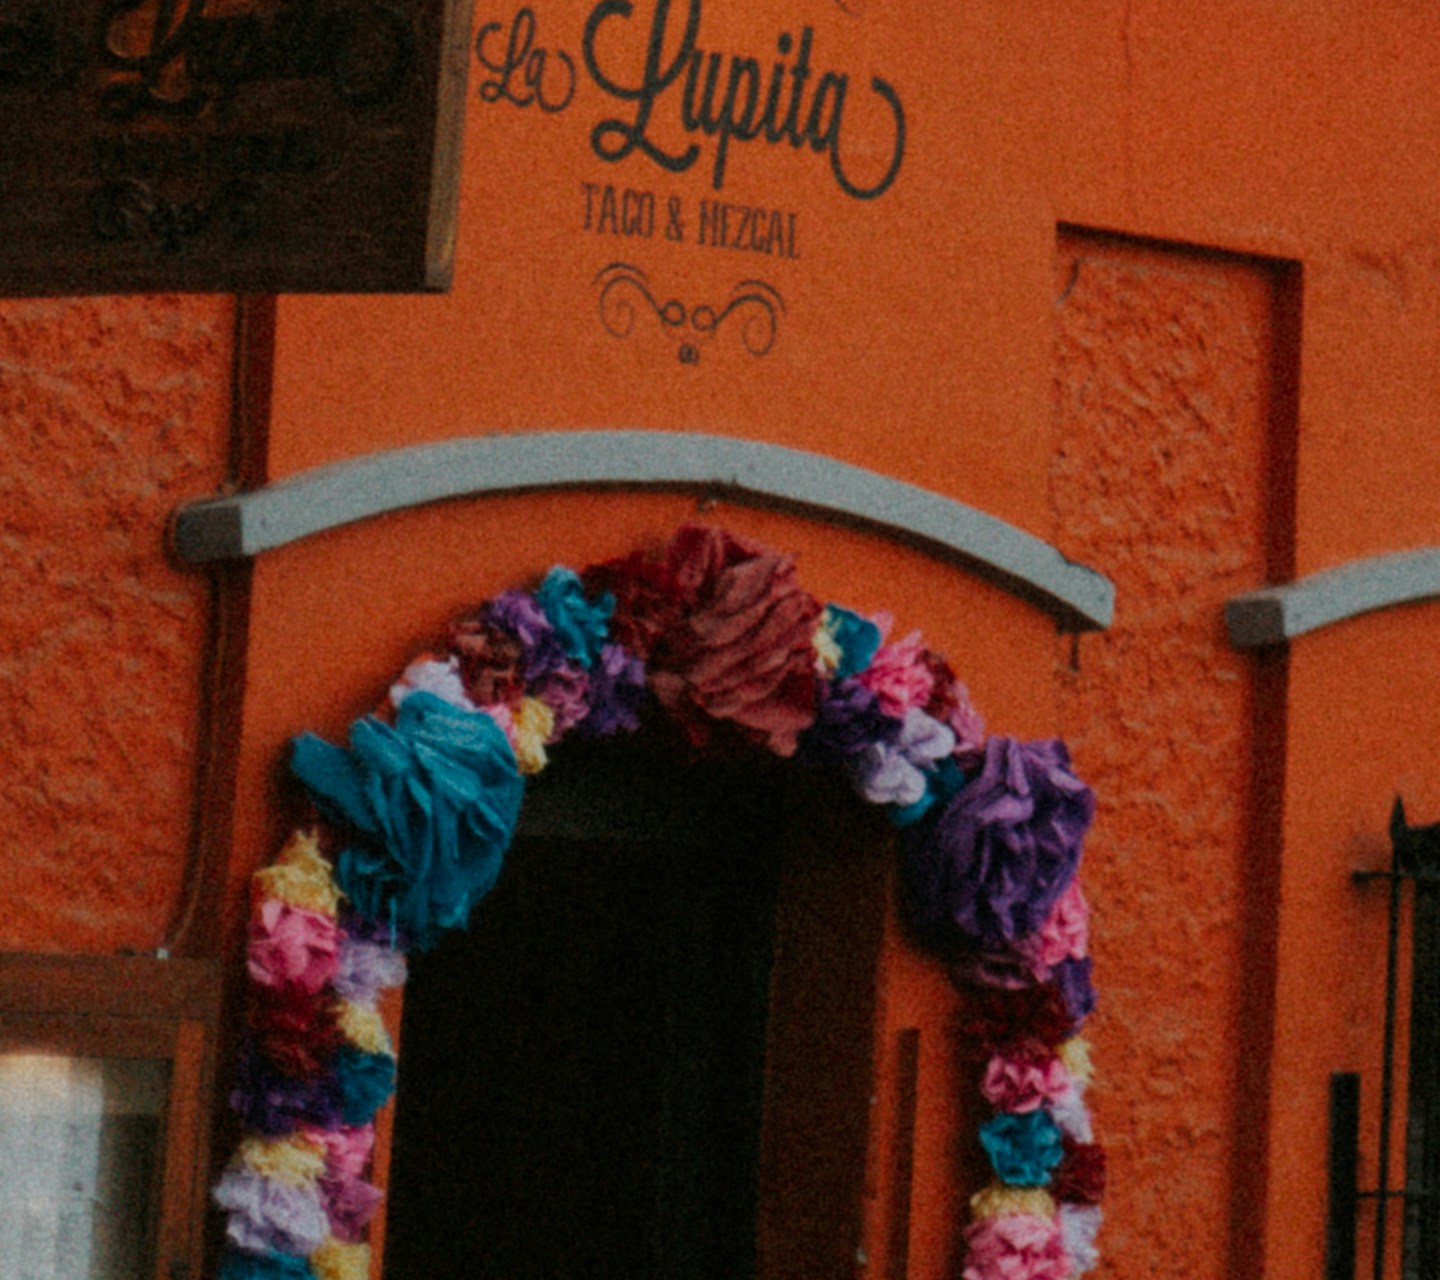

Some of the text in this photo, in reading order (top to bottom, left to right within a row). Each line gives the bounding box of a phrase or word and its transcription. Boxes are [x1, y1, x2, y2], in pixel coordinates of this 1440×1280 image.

[475, 7, 578, 114] La
[580, 182, 800, 260] TACO & MEZCAL
